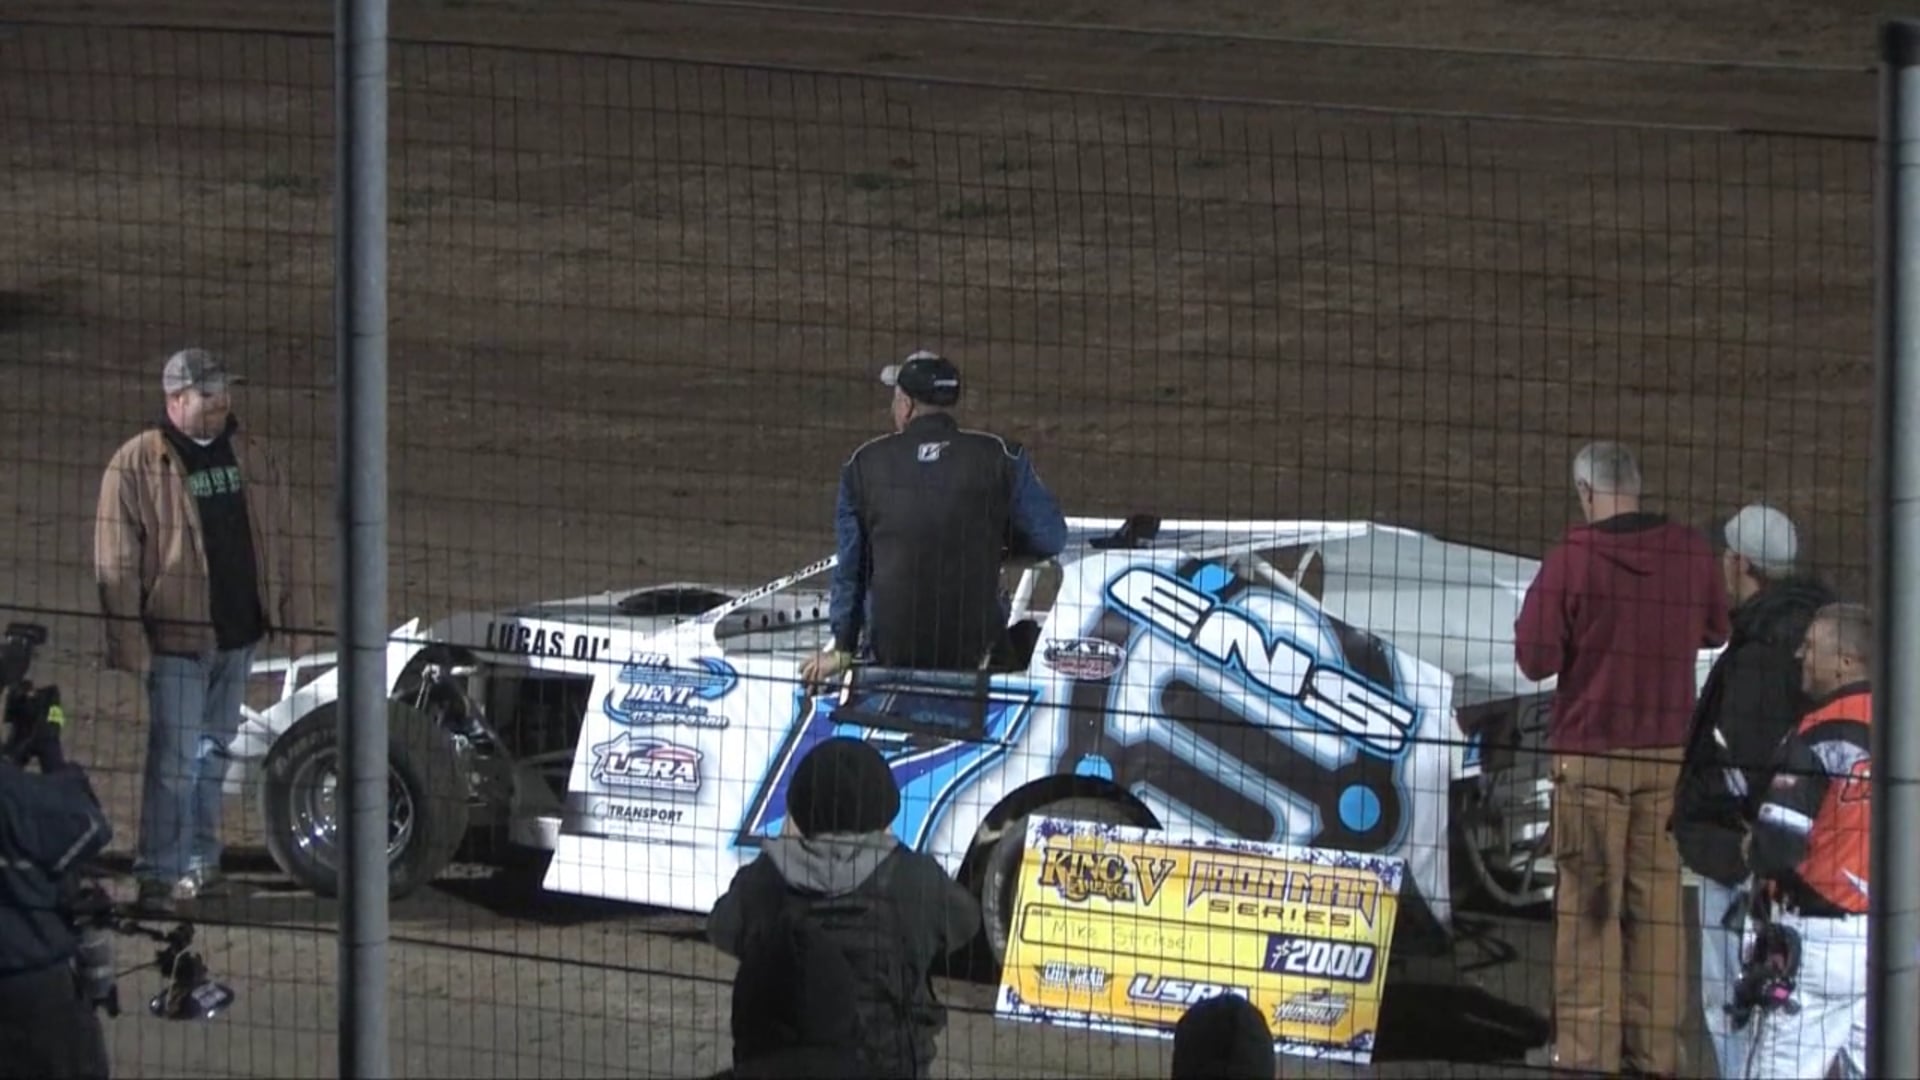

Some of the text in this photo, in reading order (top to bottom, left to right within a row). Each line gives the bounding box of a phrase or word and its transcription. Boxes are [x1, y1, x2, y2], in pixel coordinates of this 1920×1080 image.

[486, 622, 565, 658] LUCAS
[624, 683, 695, 705] DENT
[604, 752, 696, 783] USRA
[610, 804, 682, 822] TRANSPORT
[1038, 846, 1177, 906] KING V
[1188, 860, 1378, 930] IRON MAN
[1208, 899, 1352, 928] SERIES
[1270, 938, 1374, 980] $2000
